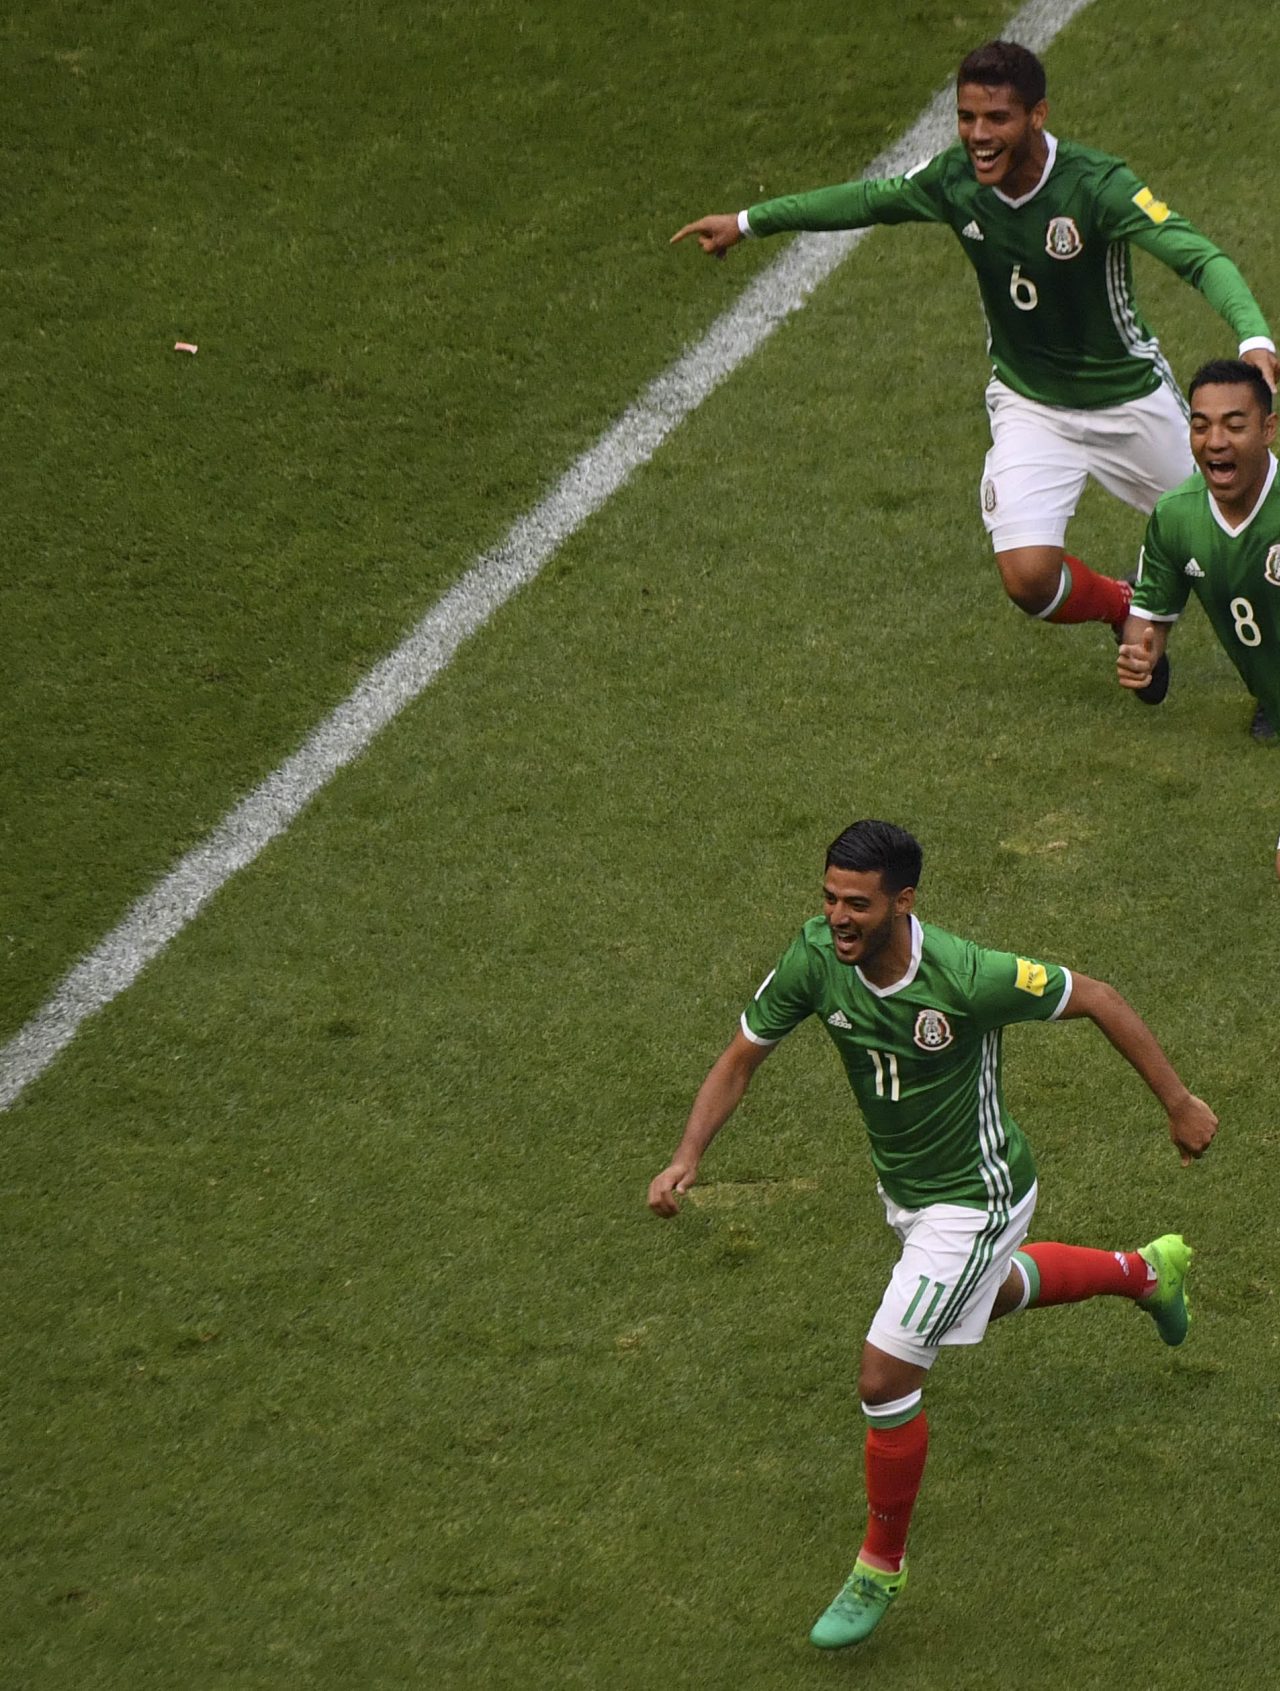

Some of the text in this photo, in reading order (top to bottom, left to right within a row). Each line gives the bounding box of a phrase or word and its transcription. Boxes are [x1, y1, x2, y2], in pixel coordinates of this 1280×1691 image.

[1009, 264, 1038, 311] 6
[1230, 597, 1262, 647] 8
[866, 1049, 900, 1102] 11
[899, 1274, 947, 1335] 11
